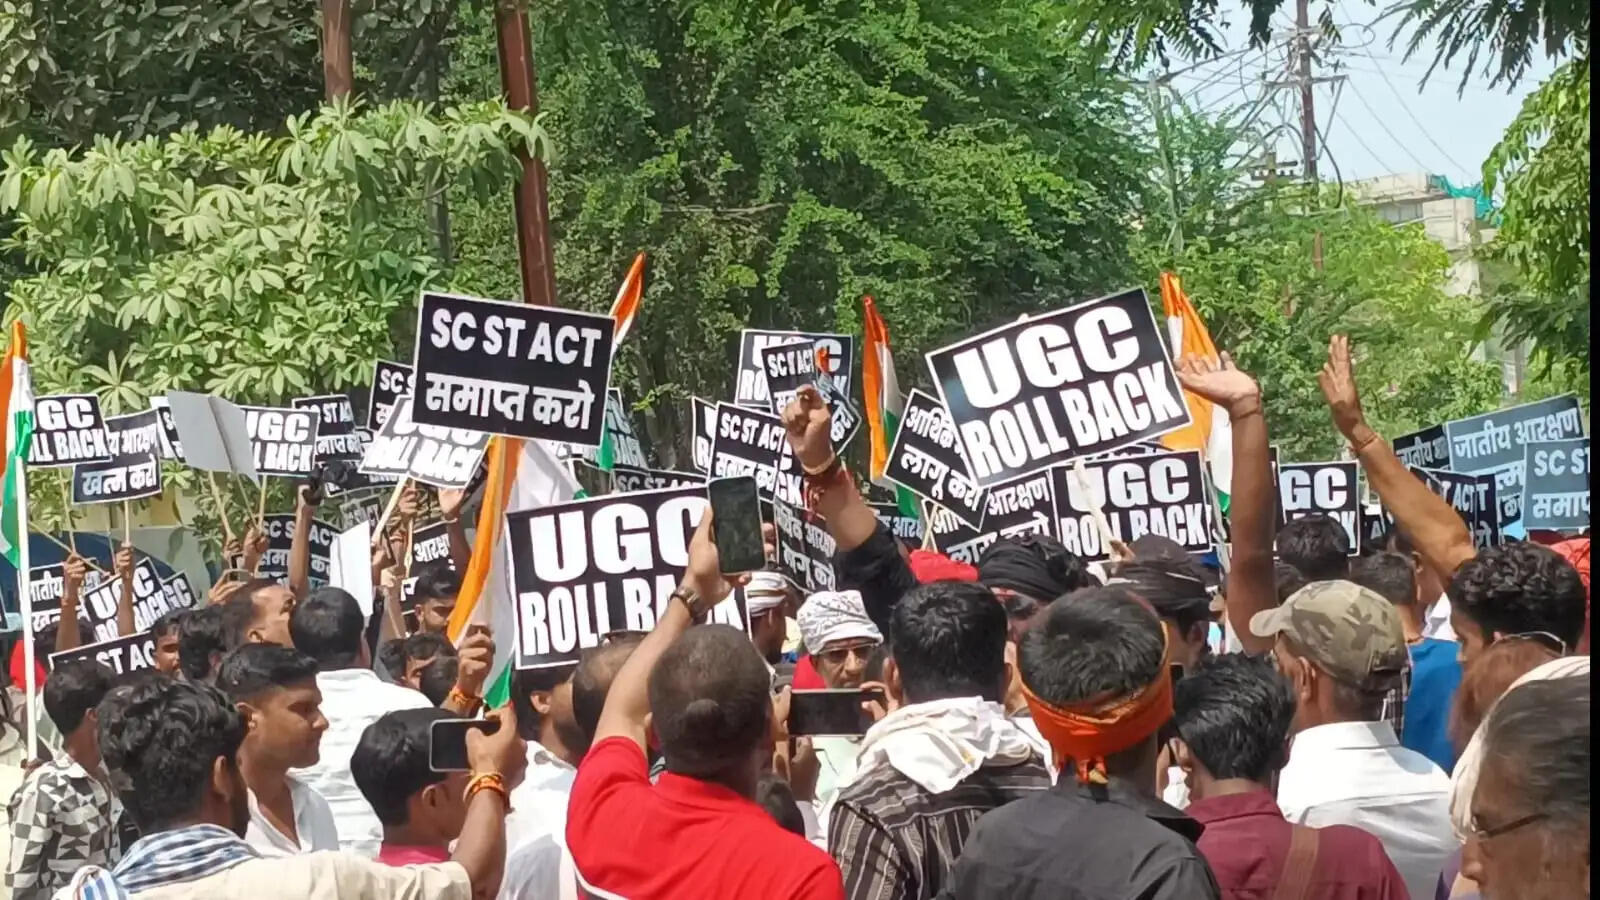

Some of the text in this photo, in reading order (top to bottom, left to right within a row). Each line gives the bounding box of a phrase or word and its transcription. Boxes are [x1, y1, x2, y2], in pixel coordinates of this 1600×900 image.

[430, 308, 602, 367] SC ST ACT
[953, 307, 1140, 408] UGC
[379, 368, 404, 393] SC
[425, 372, 529, 422] समाप्त
[532, 379, 595, 430] करो
[53, 428, 109, 460] BACK
[720, 412, 740, 440] SC
[741, 418, 759, 444] ST
[757, 423, 786, 453] ACT
[961, 361, 1183, 479] ROLL BACK
[1453, 420, 1511, 459] जातीय
[1513, 407, 1580, 445] आरक्षण
[82, 453, 157, 496] खत्म करो
[264, 442, 313, 472] BACK
[901, 443, 950, 500] लागू
[1534, 449, 1566, 477] SC
[988, 477, 1049, 516] आरक्षण
[1066, 458, 1189, 512] UGC
[1280, 467, 1347, 510] GC
[529, 496, 711, 583] UGC
[1129, 503, 1208, 547] BACK
[519, 582, 611, 656] ROLL
